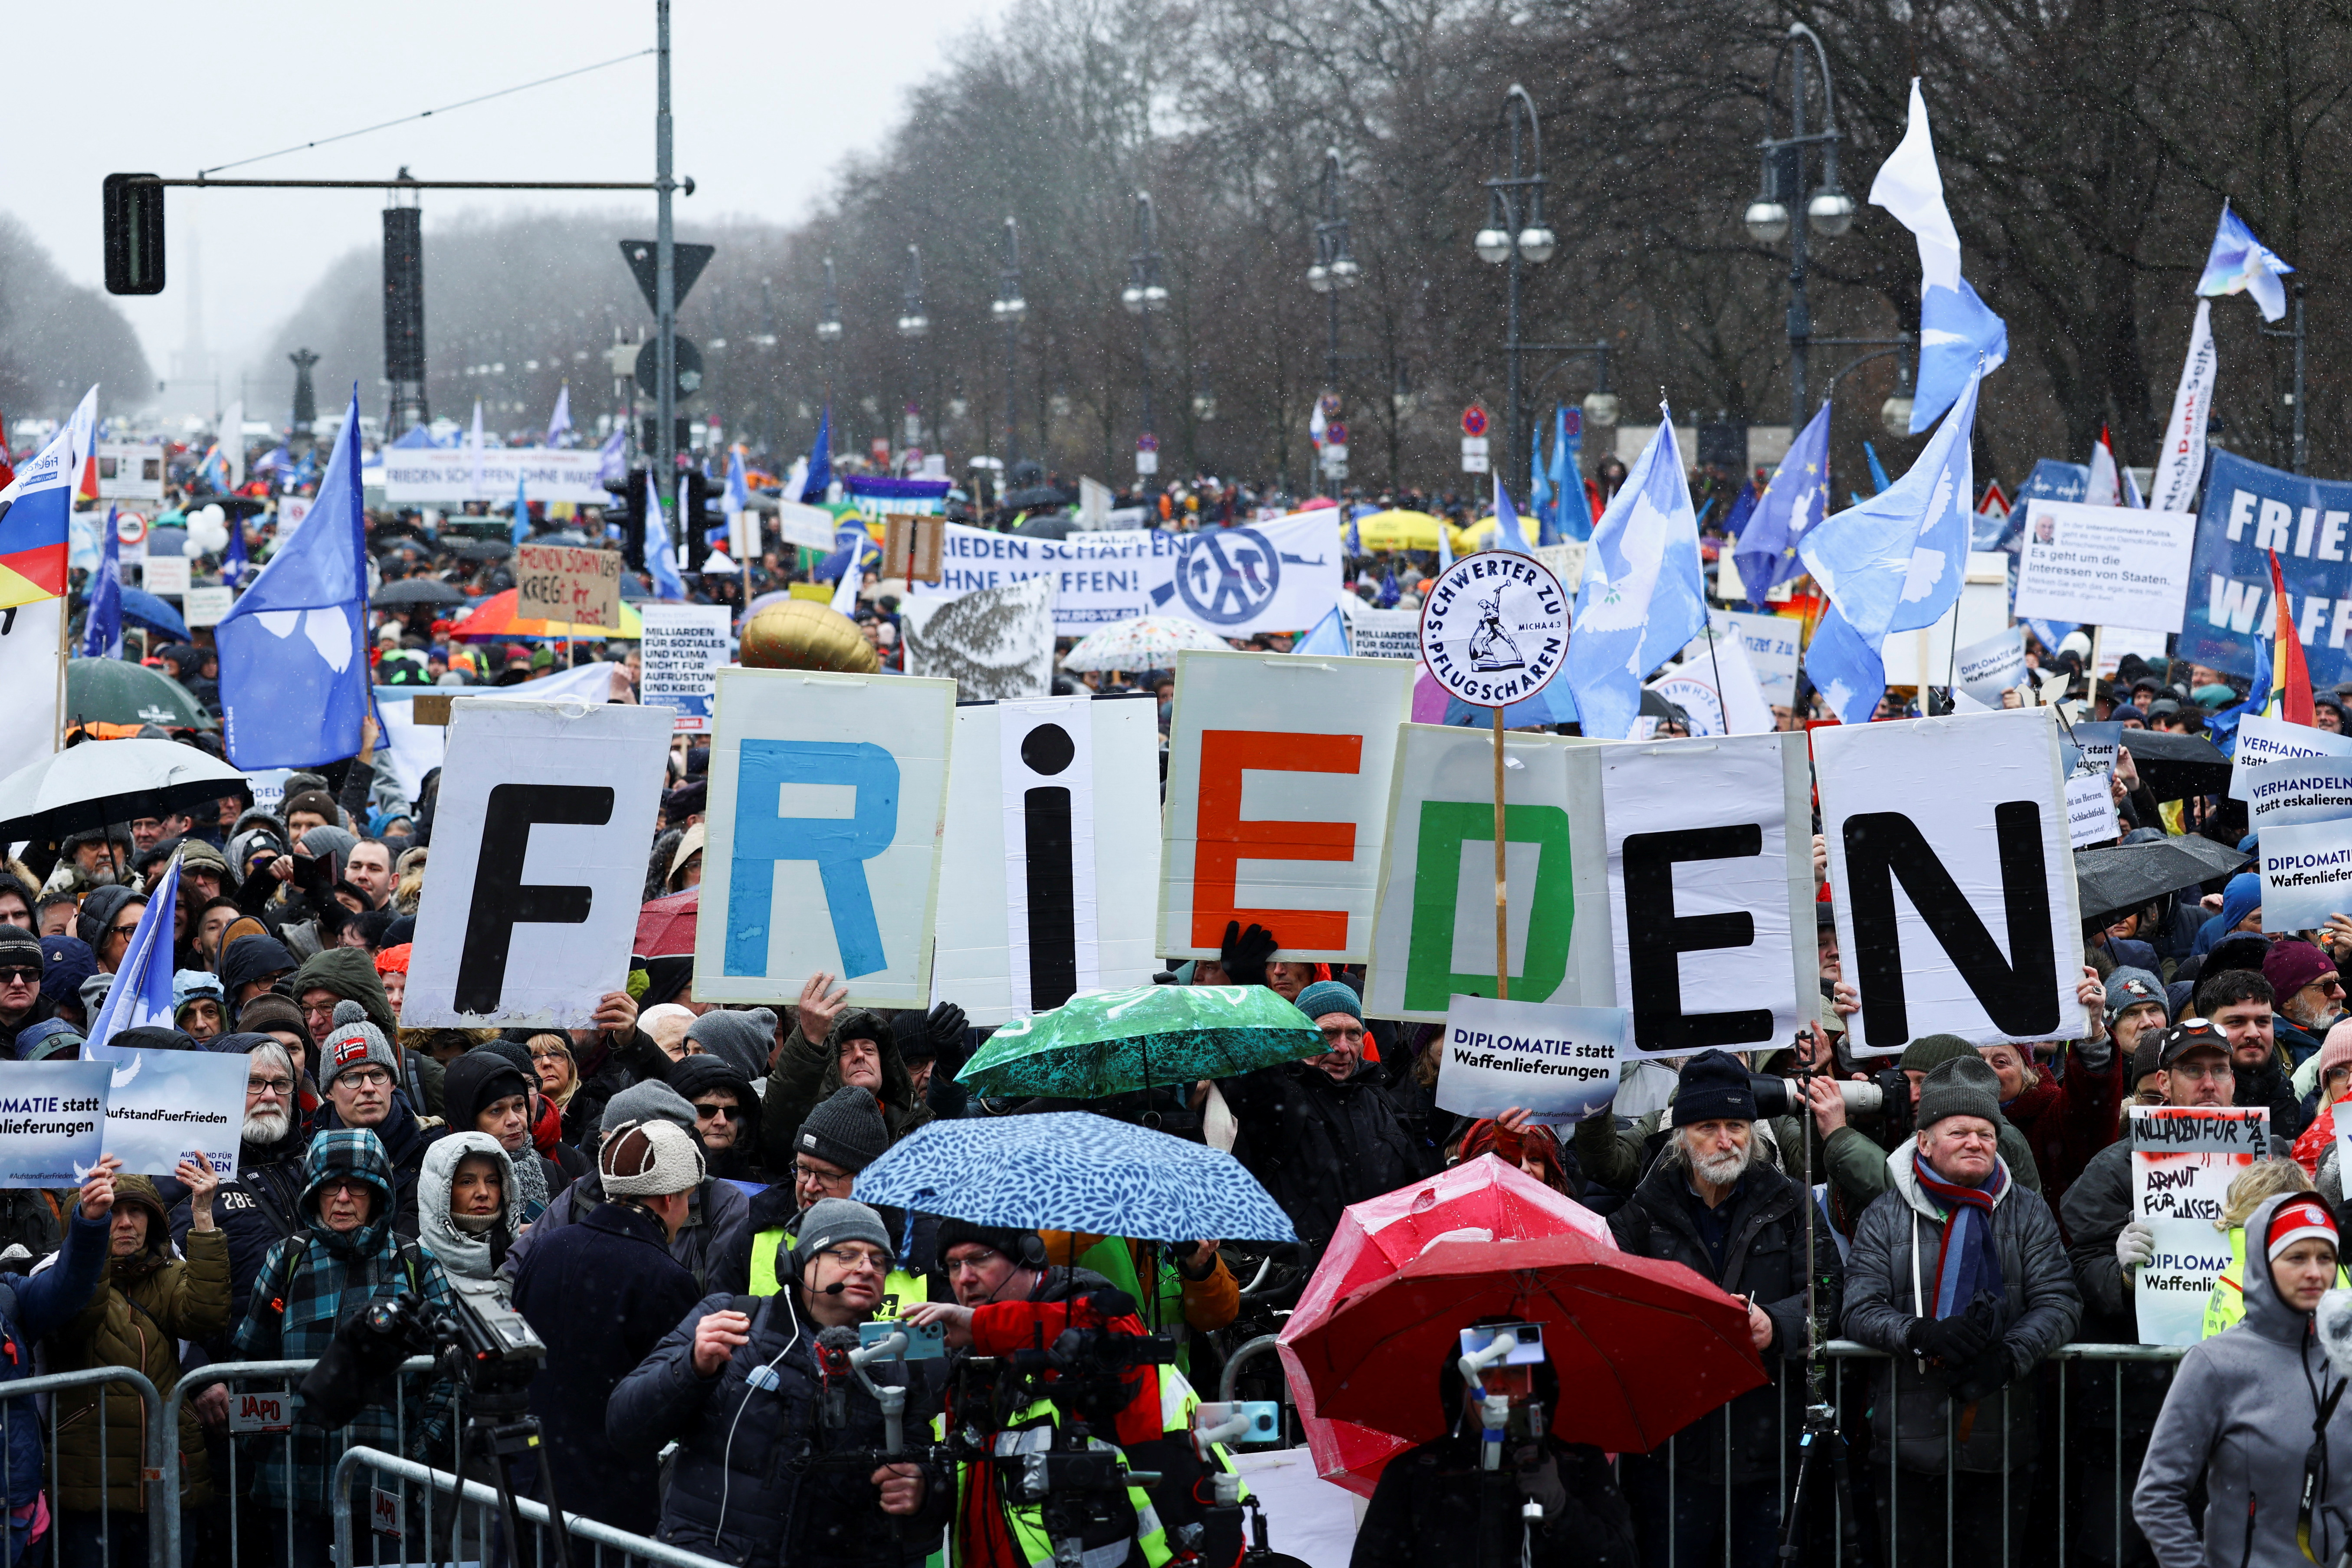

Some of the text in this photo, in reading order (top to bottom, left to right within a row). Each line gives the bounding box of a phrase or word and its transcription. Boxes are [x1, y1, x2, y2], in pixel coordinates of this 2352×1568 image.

[2086, 523, 2144, 535] internationalen
[2227, 489, 2352, 562] FRIE
[2118, 535, 2159, 546] Demokratie
[519, 548, 562, 571] MEINEN
[565, 549, 599, 574] SOHN
[2031, 548, 2120, 566] Es geht um die
[2029, 563, 2171, 586] Interessen von Staaten.
[1428, 560, 1536, 631] SCHWERTER
[1537, 584, 1561, 614] ZU
[646, 627, 715, 636] MILLIARDEN
[1518, 622, 1547, 631] MICHA
[646, 636, 726, 648] FÜR SOZIALES
[1356, 640, 1377, 650] FÜR
[646, 659, 705, 670] NICHT FÜR
[672, 651, 708, 659] KLIMA
[1381, 651, 1414, 660] KLIMA
[1961, 650, 2010, 674] DIPLOMATIE
[645, 671, 716, 681] AUFRÜSTUN
[1428, 637, 1561, 701] PFLUGSCHAREN
[1965, 657, 2023, 683] Waffenlieferungen
[645, 684, 706, 693] UND KRIEG
[2087, 745, 2113, 754] statt
[2075, 796, 2082, 805] im
[2082, 792, 2104, 803] Herzen,
[2253, 777, 2352, 800] VERHANDELN
[2072, 807, 2107, 823] Schlachtfeld.
[2256, 794, 2352, 816] statt eskalieren
[2094, 825, 2105, 835] jetzt!
[2268, 849, 2352, 871] DIPLOMATI
[1454, 1028, 1615, 1059] DIPLOMATIE statt
[1454, 1048, 1610, 1081] Waffenlieferungen
[62, 1097, 99, 1112] statt
[2204, 1112, 2238, 1144] FÜR
[2147, 1166, 2200, 1192] ARMUT
[2144, 1193, 2176, 1215] FÜR
[239, 1395, 280, 1421] JAPO
[376, 1491, 395, 1525] JAPO
